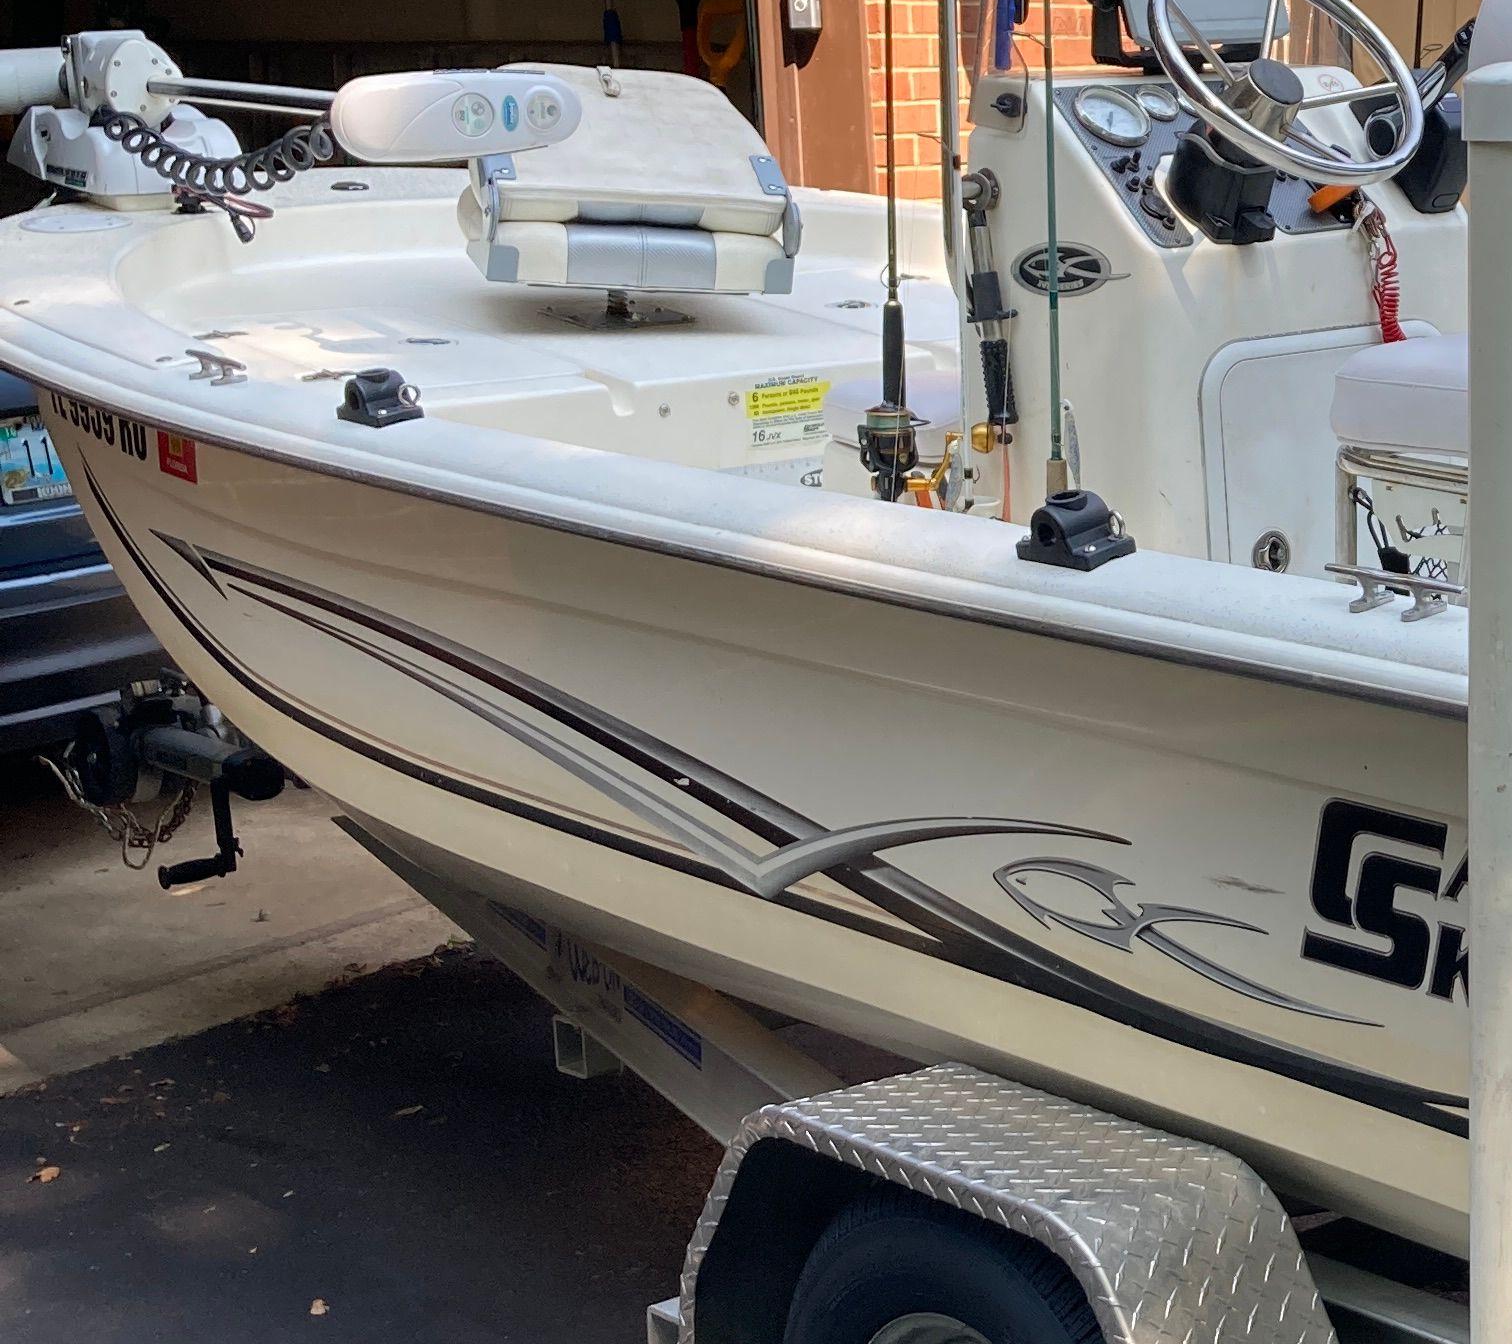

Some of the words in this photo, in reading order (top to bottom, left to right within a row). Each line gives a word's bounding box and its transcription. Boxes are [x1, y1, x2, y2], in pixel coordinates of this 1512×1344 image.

[788, 376, 818, 386] CAPACITY
[752, 391, 759, 403] 6
[752, 429, 766, 443] 16
[804, 473, 823, 487] ST
